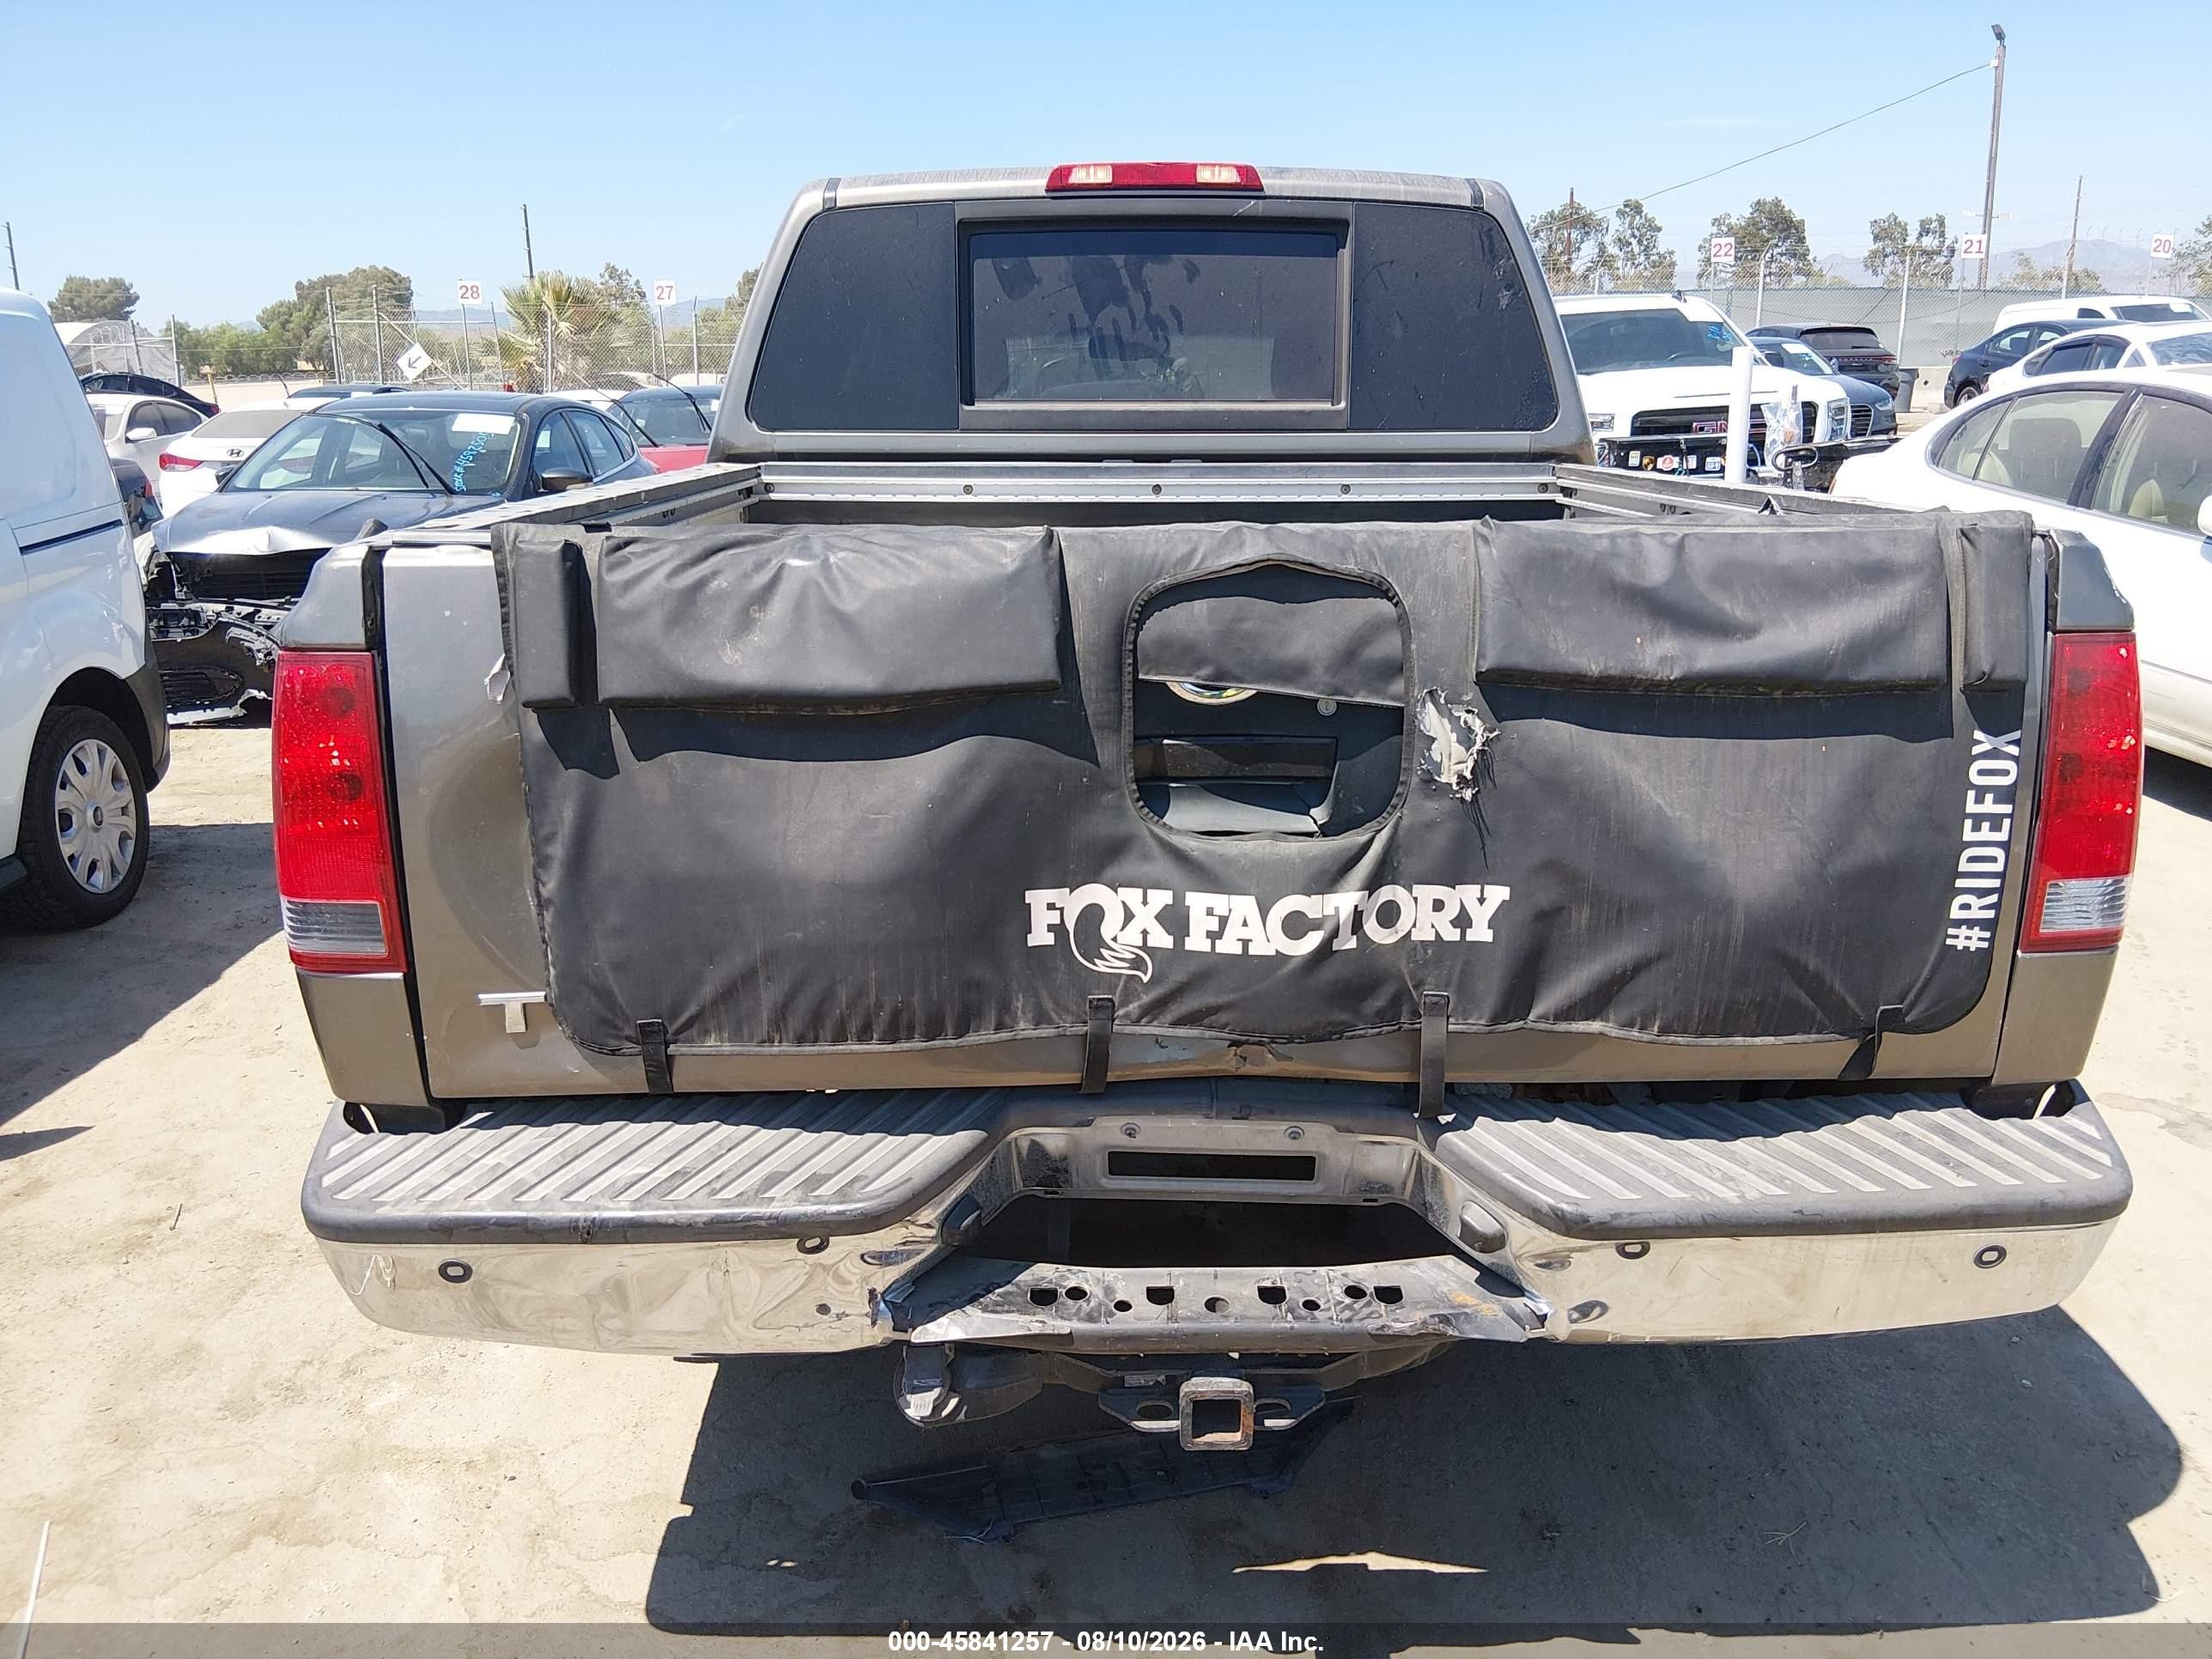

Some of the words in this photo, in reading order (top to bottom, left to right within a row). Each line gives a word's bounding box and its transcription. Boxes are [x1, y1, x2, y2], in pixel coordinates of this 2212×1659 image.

[1713, 243, 1733, 256] 22
[1964, 240, 1984, 253] 21
[2153, 239, 2172, 254] 20
[459, 285, 480, 299] 28
[656, 286, 674, 300] 27
[1945, 730, 2021, 951] #RIDEFOX
[1025, 883, 1174, 982] FOX
[1185, 884, 1510, 956] FACTORY
